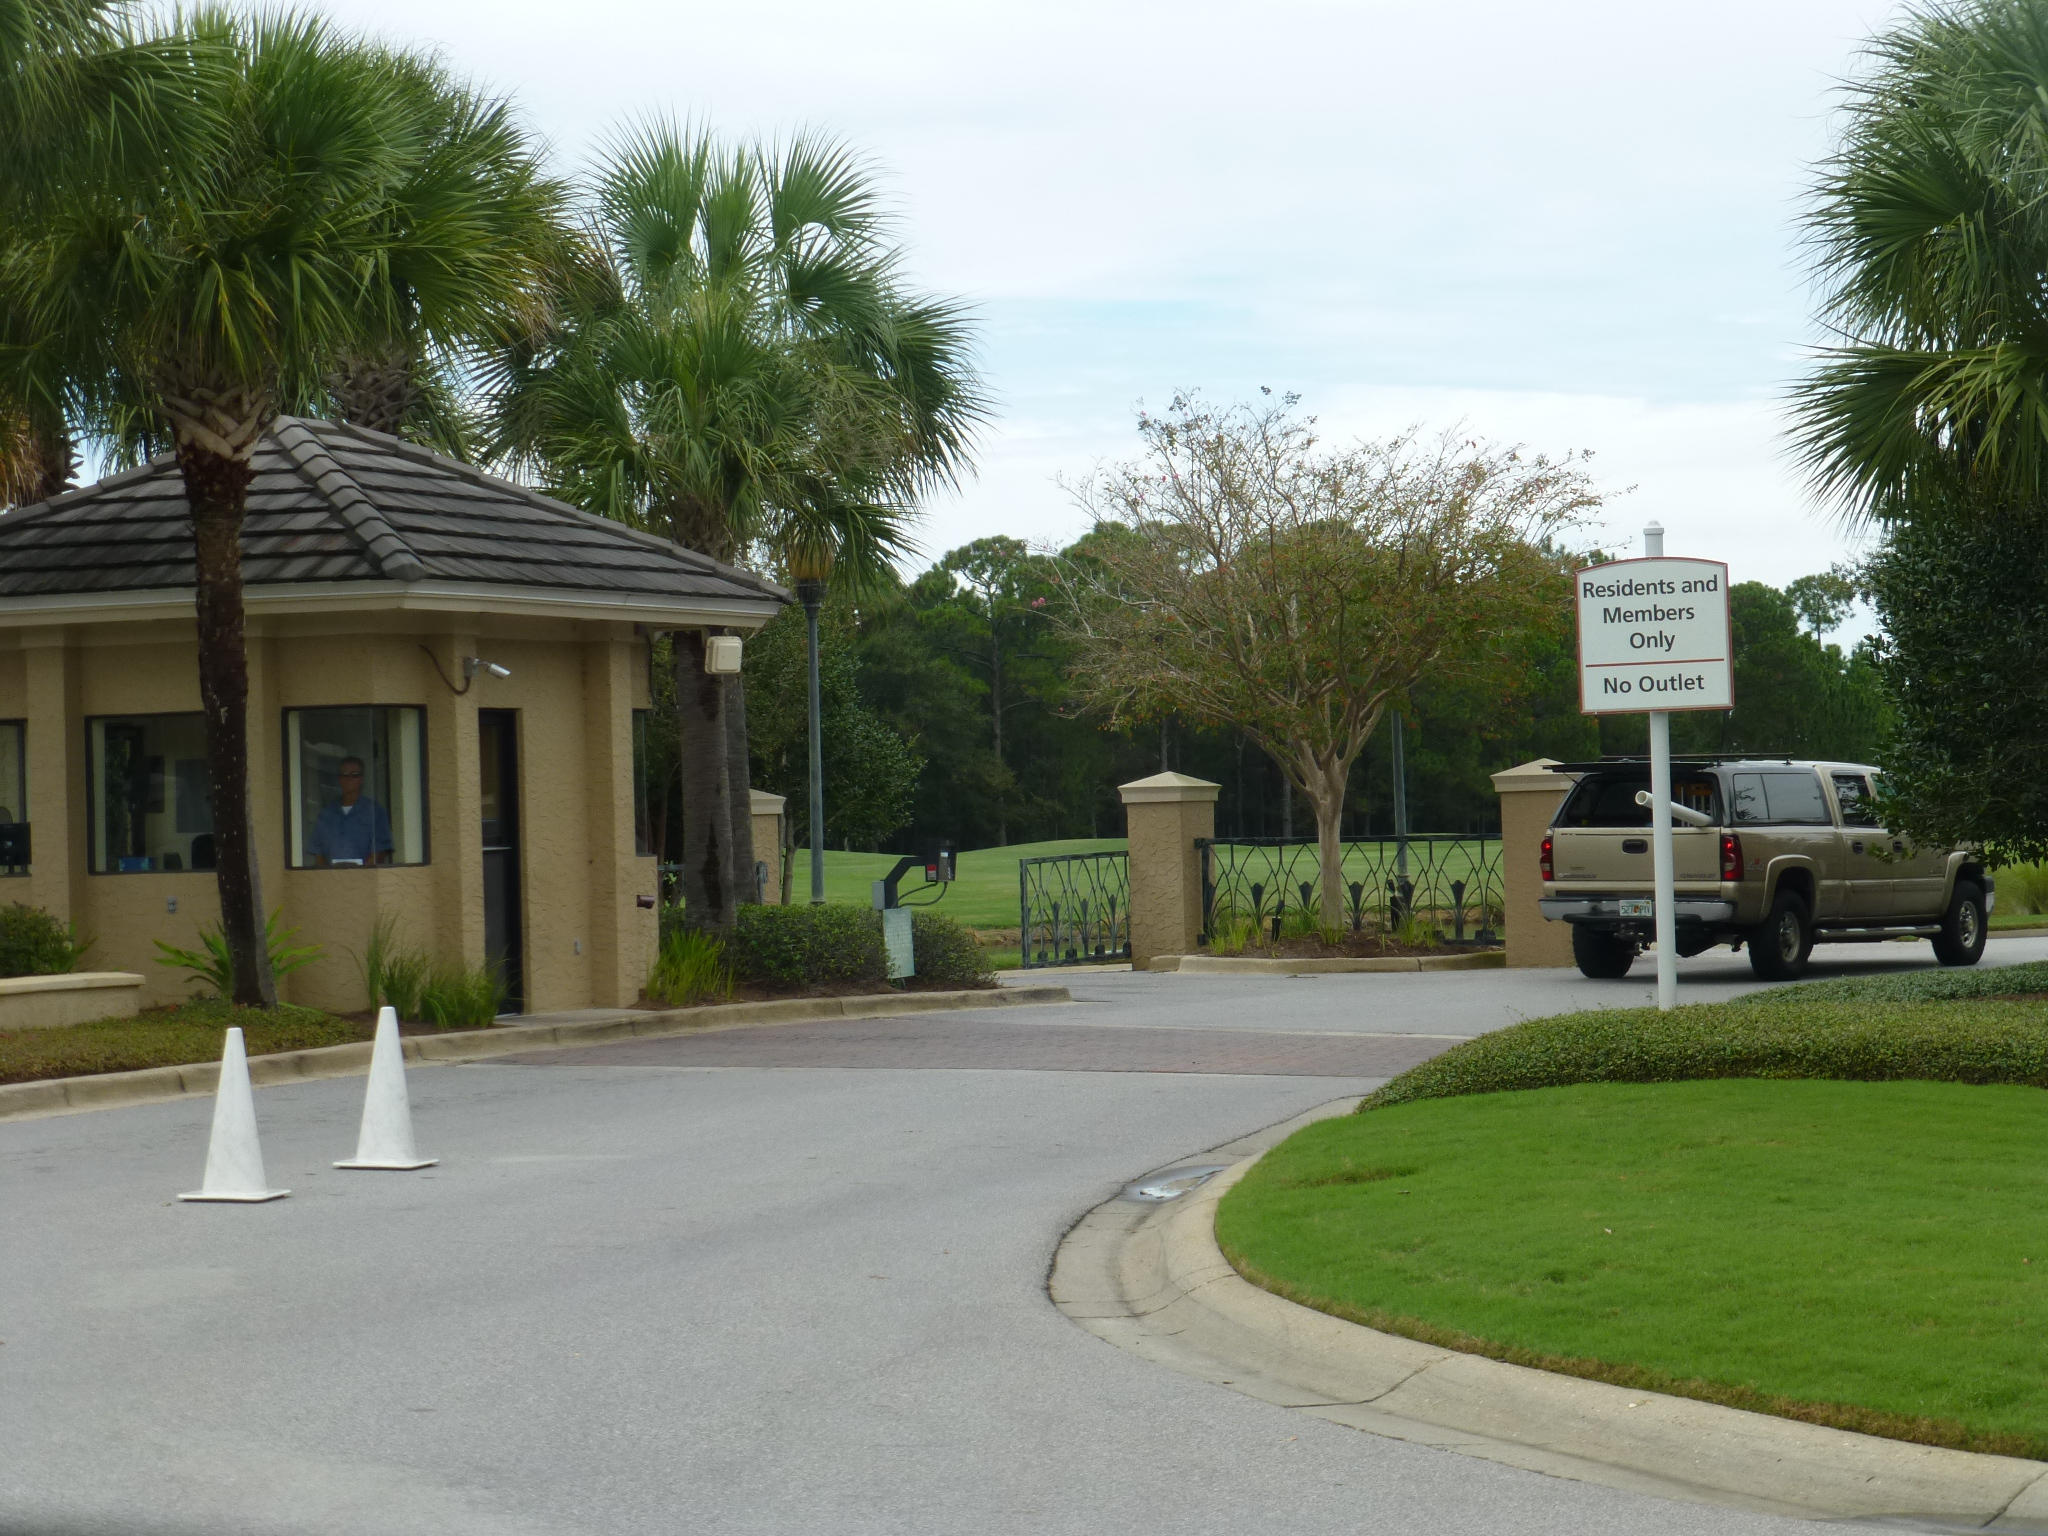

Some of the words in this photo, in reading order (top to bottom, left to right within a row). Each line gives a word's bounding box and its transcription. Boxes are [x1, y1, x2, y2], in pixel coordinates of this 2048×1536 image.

[1583, 578, 1675, 599] Residents
[1681, 574, 1718, 593] and
[1603, 604, 1695, 624] Members
[1629, 630, 1675, 652] Only
[1604, 677, 1632, 694] No
[1639, 673, 1705, 693] Outlet
